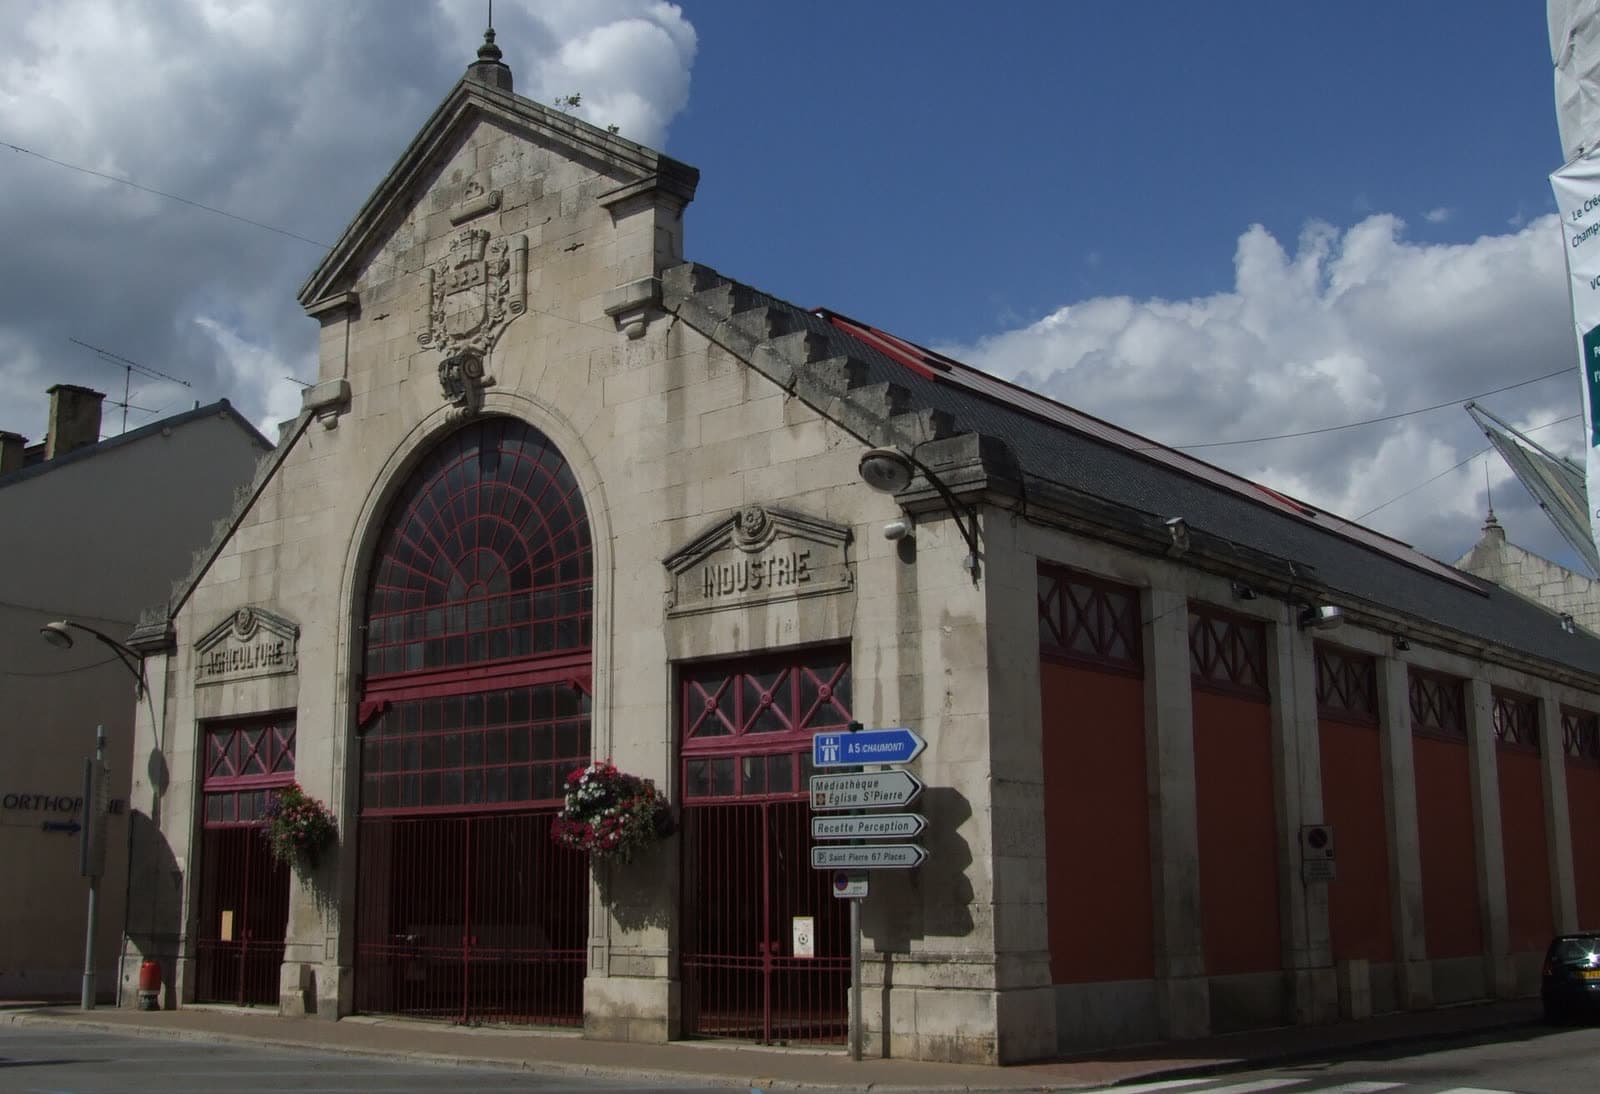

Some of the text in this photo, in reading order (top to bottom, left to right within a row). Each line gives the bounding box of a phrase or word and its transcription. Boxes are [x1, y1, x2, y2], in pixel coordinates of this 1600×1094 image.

[1571, 222, 1600, 248] Champ
[704, 549, 811, 598] INDUSTRIE
[207, 640, 284, 676] AGRICULTURE
[818, 820, 909, 833] Recette Perception
[829, 853, 846, 862] Saint
[849, 852, 869, 862] Pierre
[872, 852, 881, 861] 67
[883, 852, 906, 861] Places
